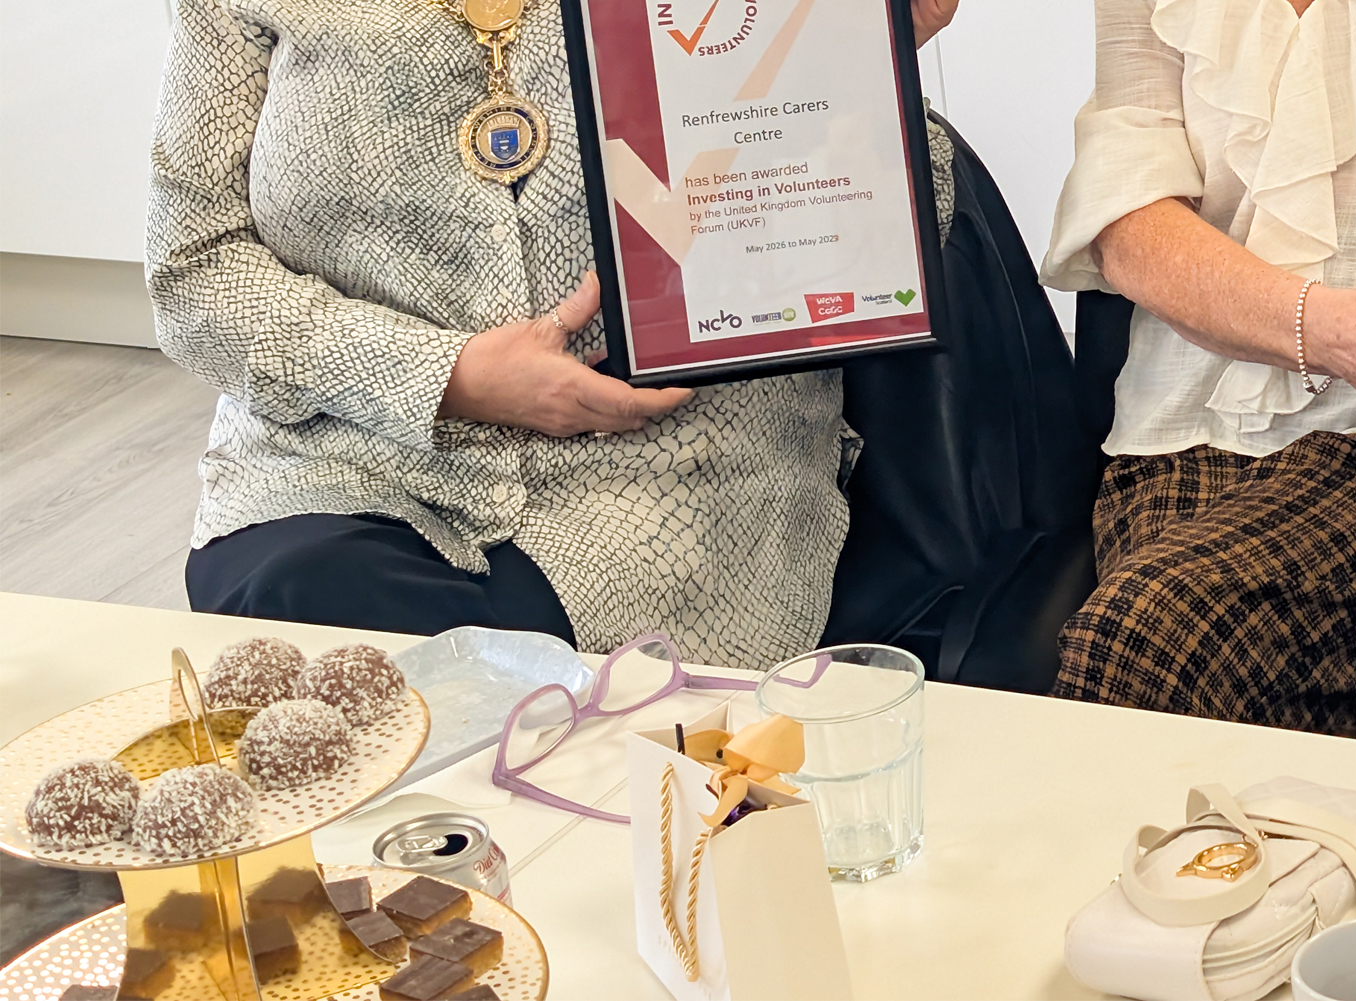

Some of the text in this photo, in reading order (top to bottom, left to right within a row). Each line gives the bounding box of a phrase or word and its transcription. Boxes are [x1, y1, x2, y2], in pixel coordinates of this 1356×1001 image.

[682, 99, 829, 127] Renfrewshire Carers
[733, 128, 783, 144] Centre
[685, 161, 809, 189] has been awarded
[687, 175, 851, 206] Investing in Volunteers
[689, 189, 873, 221] by the United Kingdom Volunteering
[690, 216, 766, 236] Forum (UKVF)
[745, 244, 764, 254] May
[766, 241, 787, 252] 2026
[788, 240, 797, 248] to
[798, 236, 817, 247] May
[861, 293, 893, 303] Volunteer
[698, 309, 743, 334] NCVO
